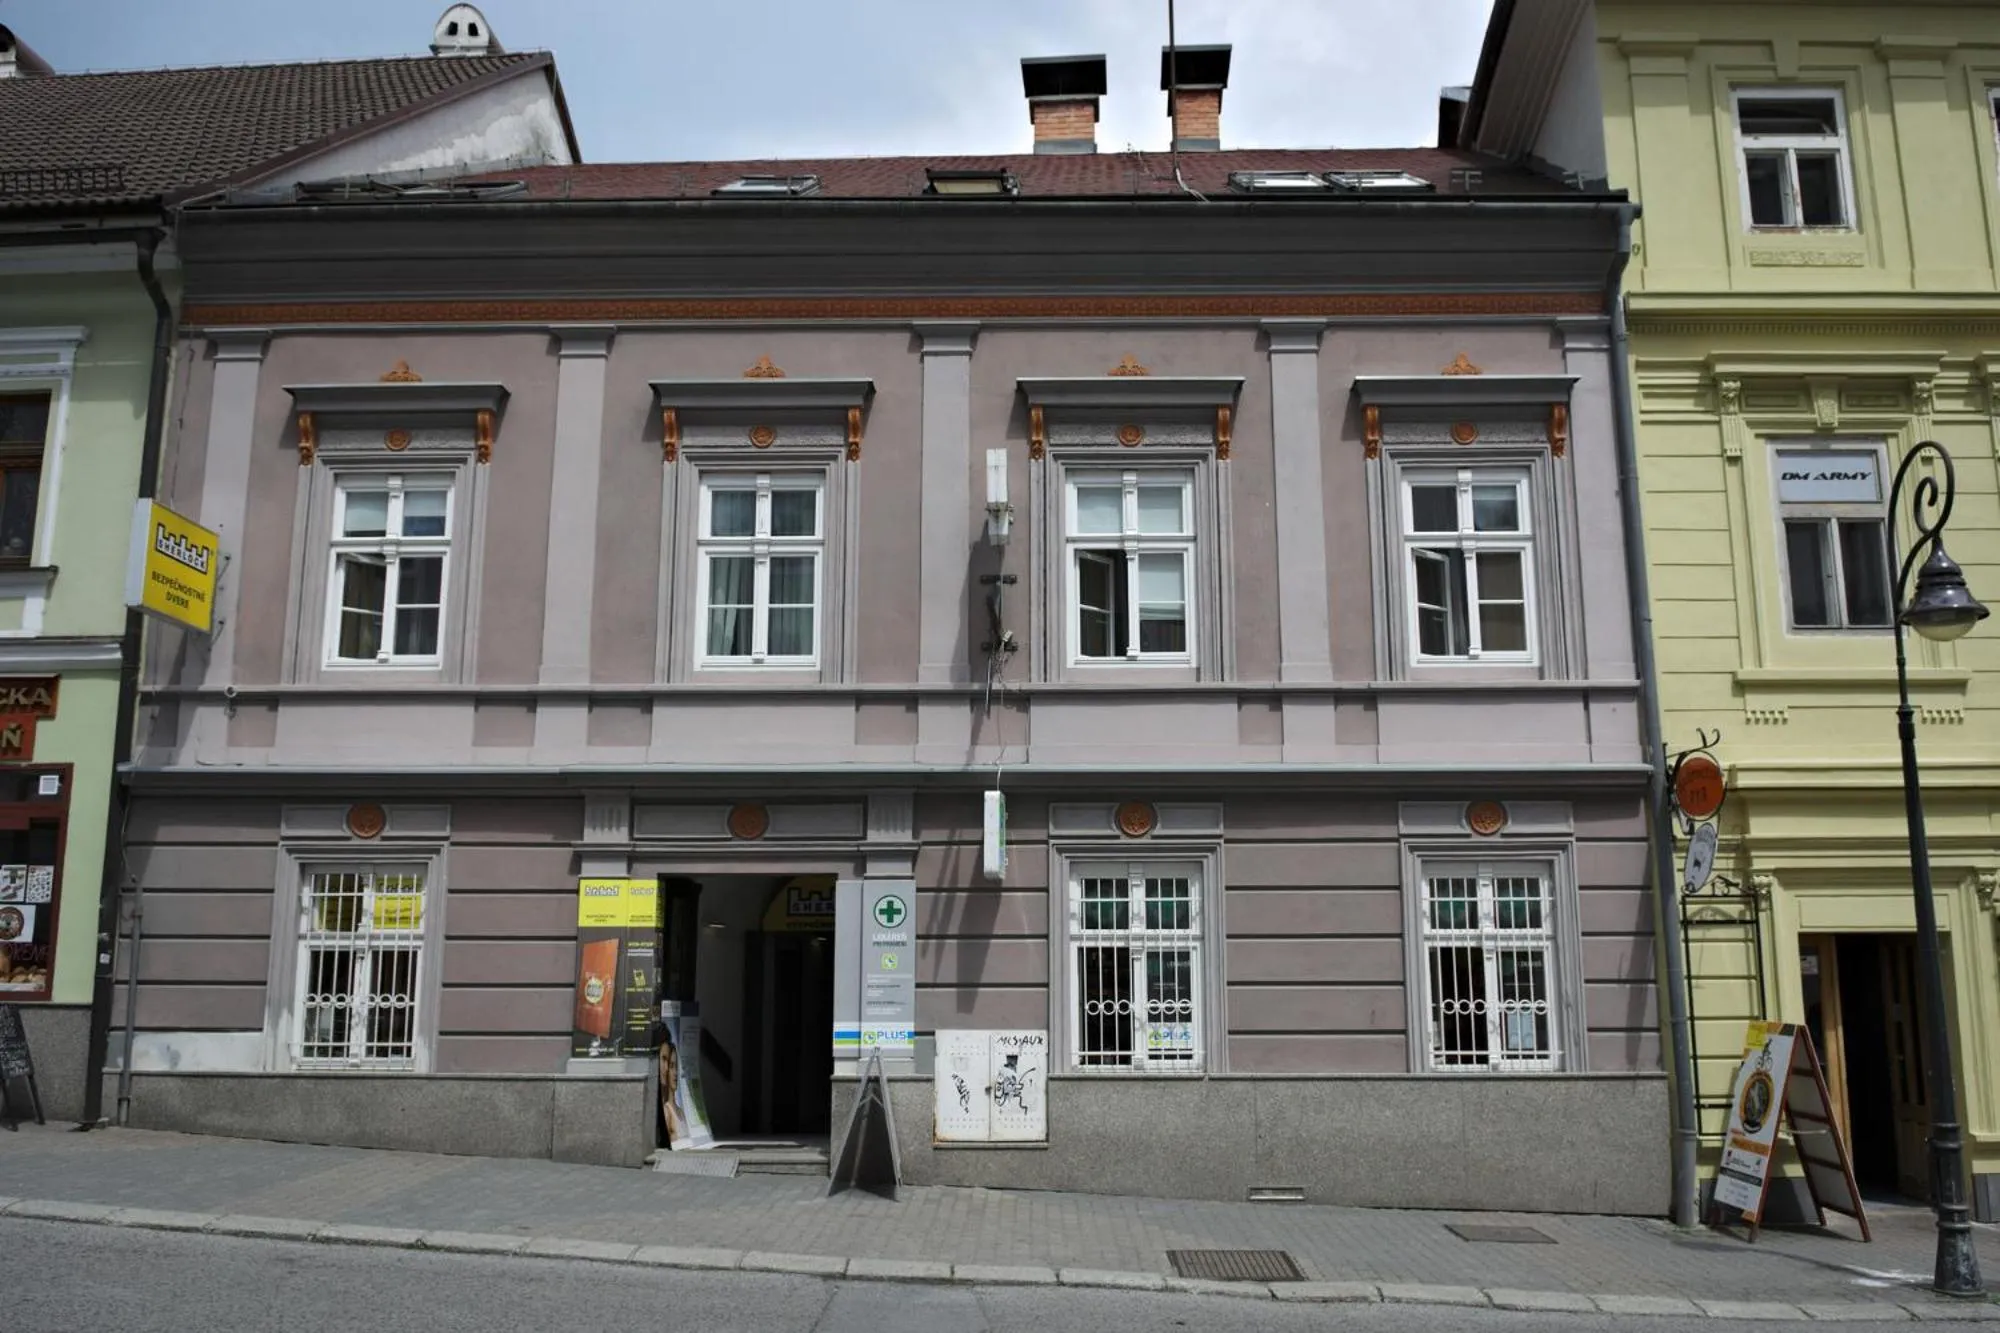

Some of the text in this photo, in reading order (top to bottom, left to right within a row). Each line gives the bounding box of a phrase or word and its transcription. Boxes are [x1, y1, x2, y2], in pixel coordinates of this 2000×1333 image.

[1781, 472, 1872, 481] DM ARMY
[877, 1031, 906, 1040] PLUS
